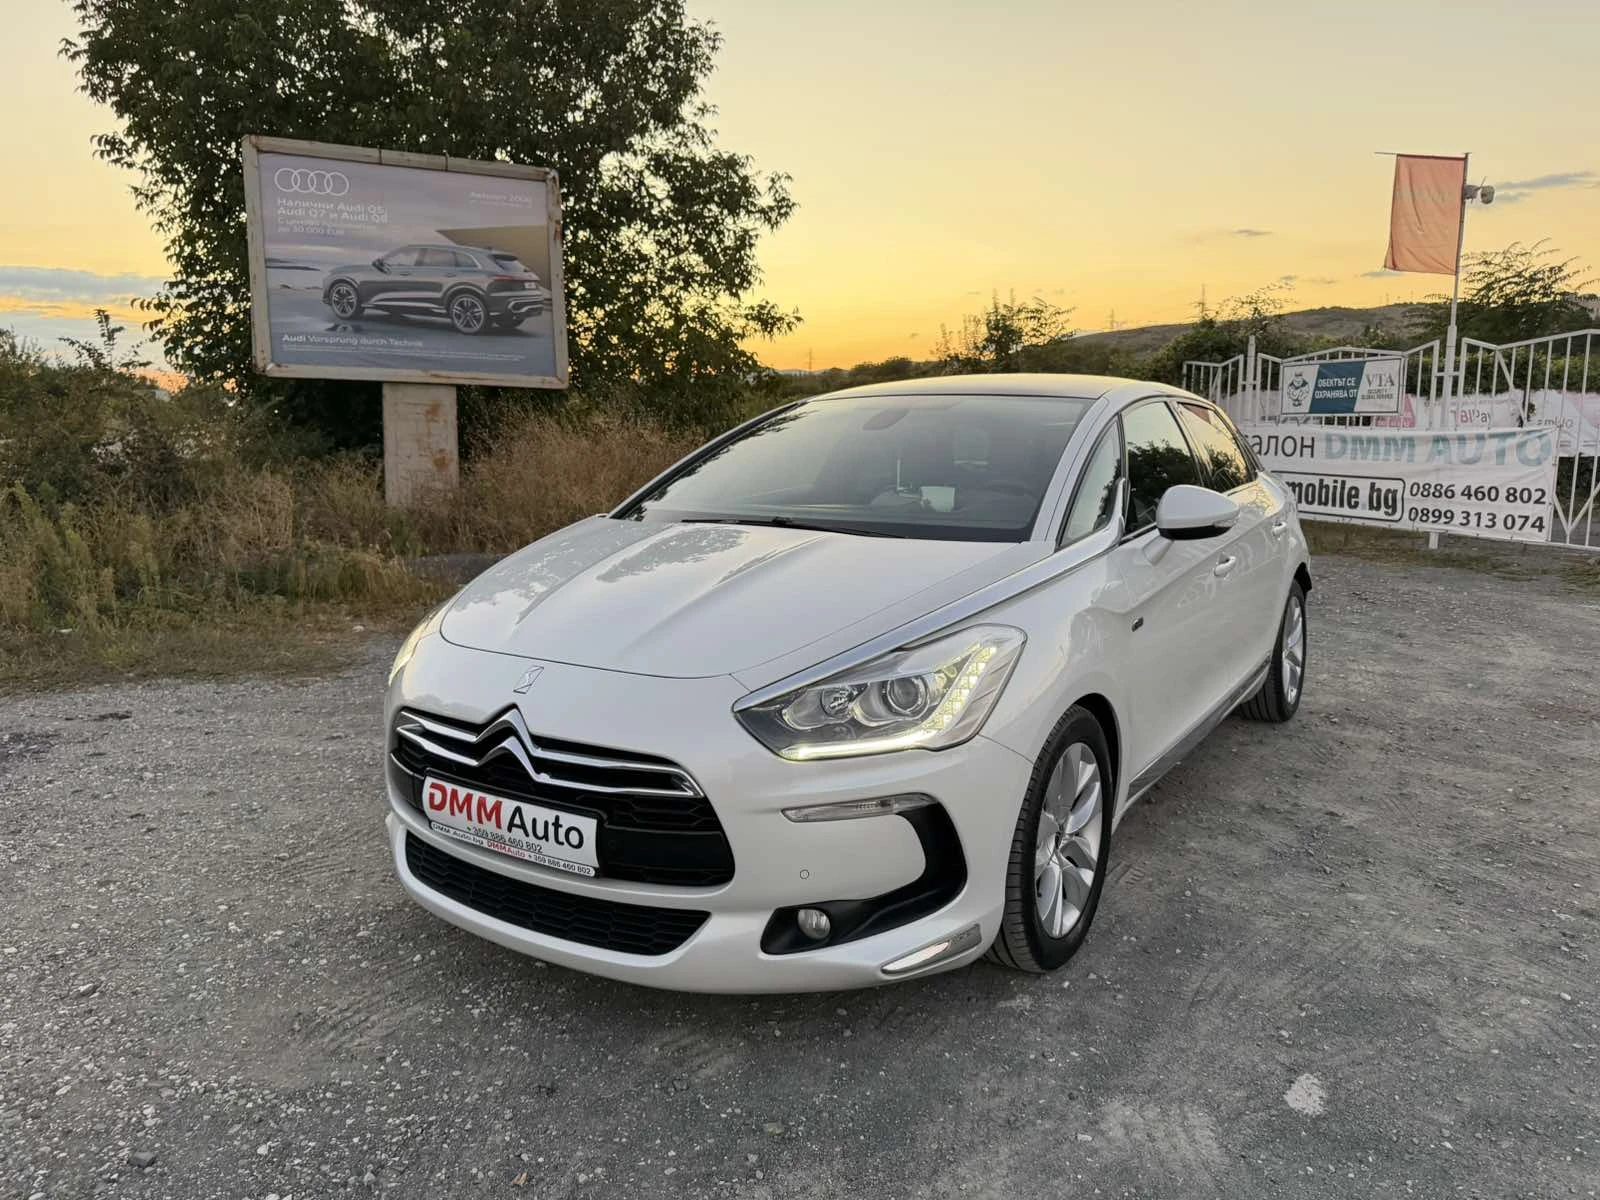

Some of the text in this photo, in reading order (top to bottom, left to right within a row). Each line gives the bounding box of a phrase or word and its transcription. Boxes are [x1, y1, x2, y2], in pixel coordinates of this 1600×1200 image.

[277, 206, 305, 216] Audi
[308, 207, 326, 218] Q7
[340, 211, 369, 222] Audi
[336, 202, 365, 212] Audi
[281, 334, 301, 342] Audi
[1318, 377, 1356, 388] ОБЕКТЪТ СЕ
[1365, 372, 1394, 388] VTA
[1315, 389, 1357, 399] ОХРАНЯВА ОТ
[1244, 431, 1552, 467] алон DMM AUTO
[1286, 479, 1398, 516] mobile.bg
[1409, 482, 1546, 505] 0886 460 802
[1408, 507, 1545, 533] 0899 313 074
[507, 836, 524, 849] 460
[525, 841, 544, 853] 802
[562, 861, 576, 872] 460
[576, 865, 591, 875] 802
